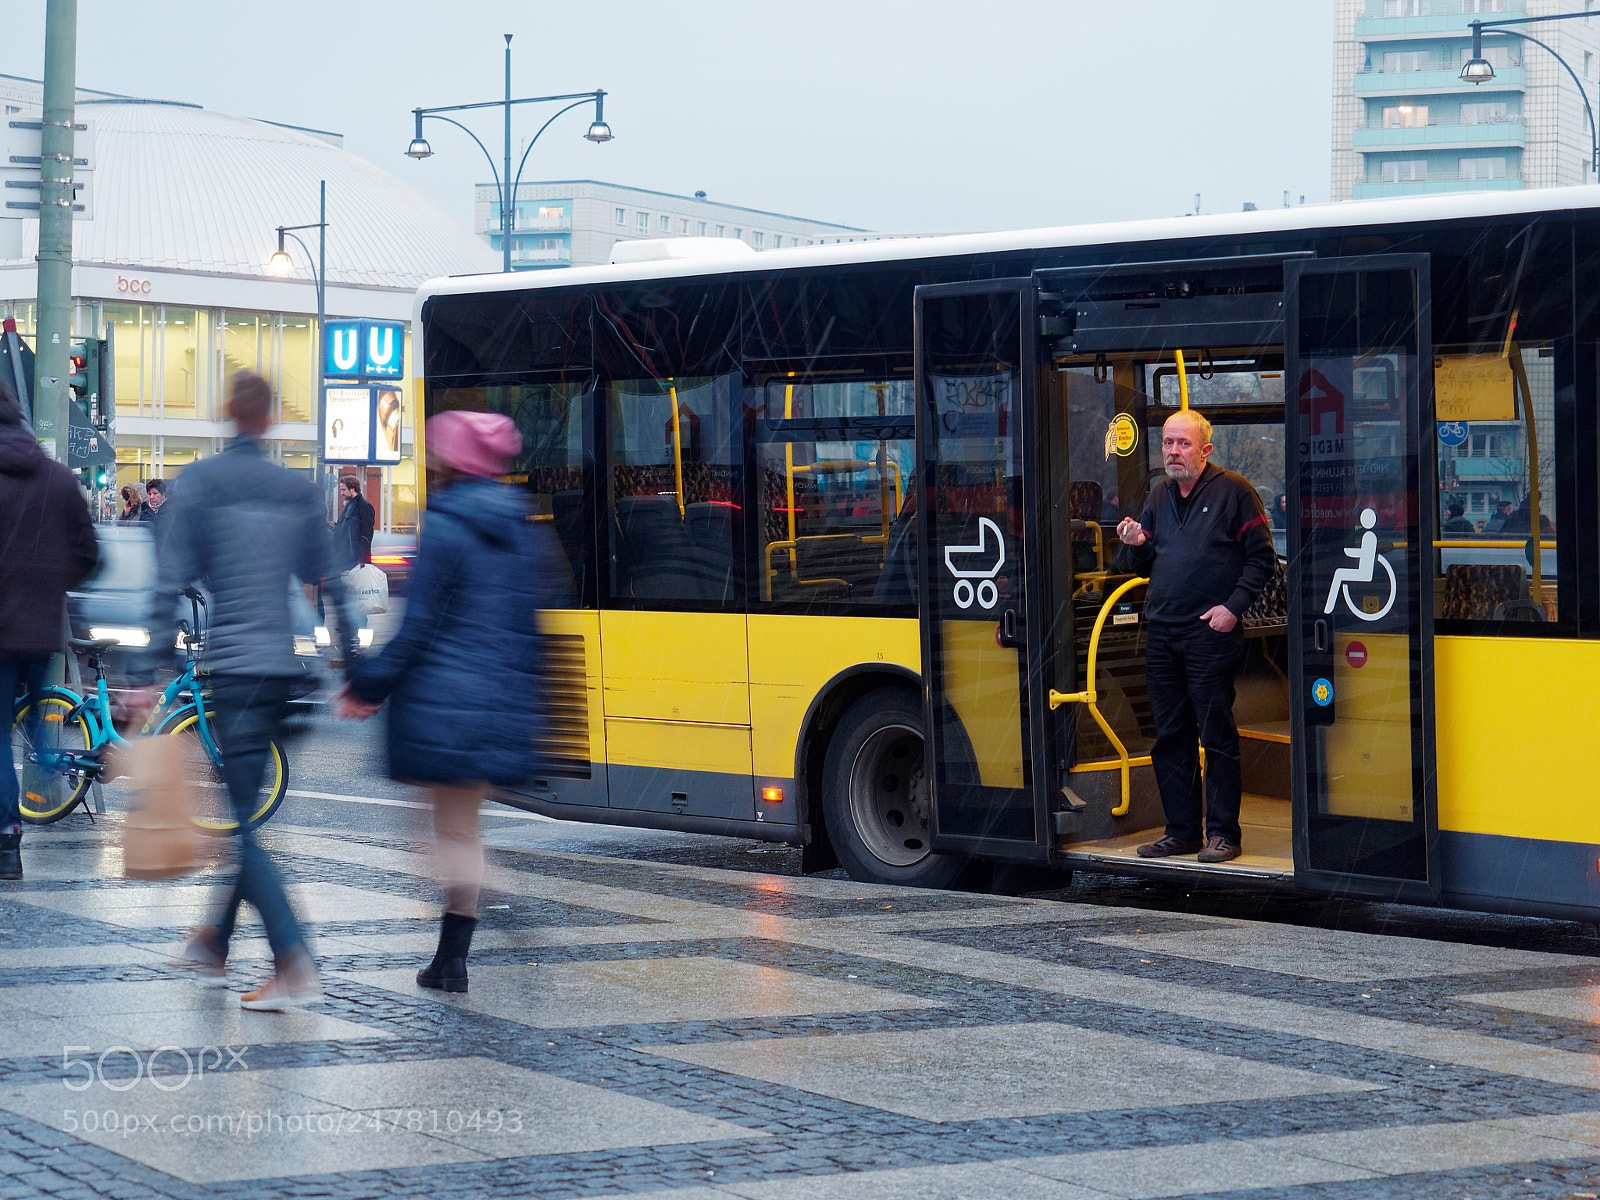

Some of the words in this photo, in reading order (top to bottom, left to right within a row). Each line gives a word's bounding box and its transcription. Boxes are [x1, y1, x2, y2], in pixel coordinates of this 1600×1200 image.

[117, 275, 152, 294] bcc
[334, 330, 357, 370] U
[370, 327, 393, 365] U
